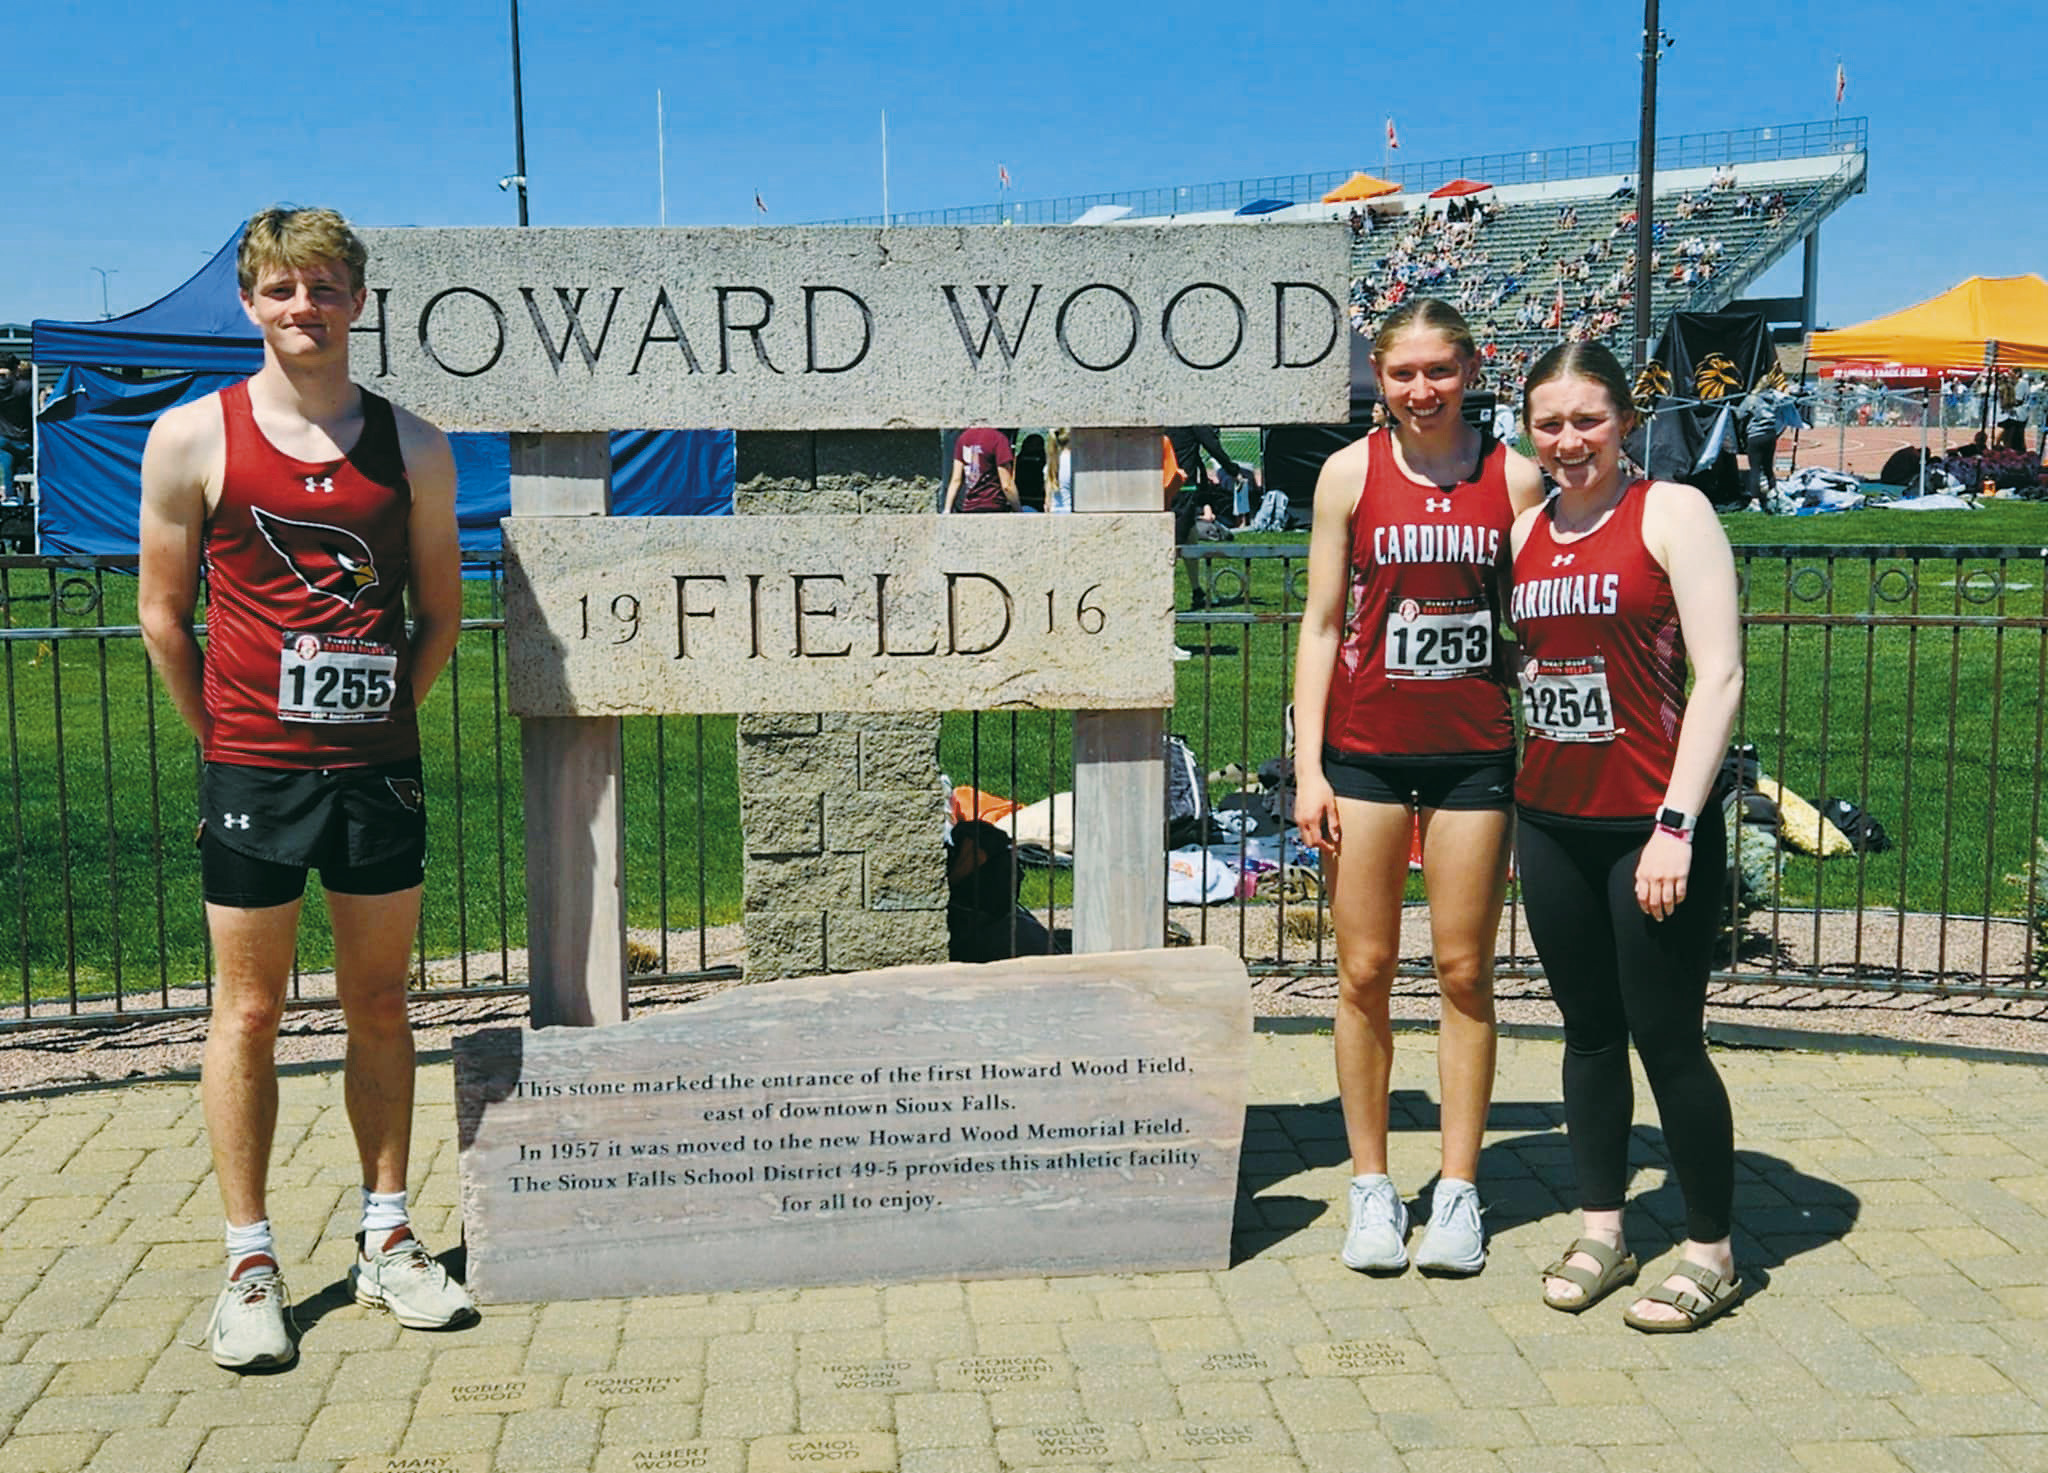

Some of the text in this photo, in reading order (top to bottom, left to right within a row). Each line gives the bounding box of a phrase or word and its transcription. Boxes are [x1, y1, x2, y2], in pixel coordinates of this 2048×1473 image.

[350, 281, 1343, 378] HOWARD WOOD
[1374, 524, 1499, 566] CARDINALS
[1511, 573, 1619, 623] CARDINALS
[578, 572, 1107, 660] 19 FIELD 16
[1393, 625, 1488, 666] 1253
[288, 665, 391, 710] 1255
[1525, 687, 1608, 728] 1254
[516, 1080, 562, 1098] This
[569, 1082, 625, 1097] stone
[633, 1075, 713, 1093] marked
[721, 1074, 754, 1089] the
[761, 1073, 854, 1089] entrance
[861, 1068, 882, 1085] of
[889, 1066, 921, 1083] the
[928, 1064, 972, 1082] first
[981, 1061, 1061, 1080] Howard
[1071, 1059, 1128, 1076] Wood
[704, 1094, 1016, 1121] east of downtown Sioux Falls.
[519, 1118, 1190, 1161] In 1957 it was moved to the new Howard Wood Memorial Field.
[509, 1149, 1200, 1193] The Sioux Falls School District 49-5 provides this athletic facility
[782, 1190, 942, 1212] for all to enjoy.
[959, 1357, 1048, 1368] GEORGIA
[1206, 1352, 1258, 1362] JOHN
[583, 1376, 682, 1388] DOROTHY
[841, 1371, 894, 1380] JOHN
[973, 1374, 1040, 1385] WOOD
[451, 1381, 527, 1394] ROBERT
[599, 1384, 668, 1395] WOOD
[834, 1378, 901, 1390] WOOD
[453, 1391, 523, 1403] WOOD
[1031, 1426, 1106, 1437] ROLLIN
[787, 1440, 860, 1451] CAROL
[1184, 1435, 1254, 1446] WOOD
[631, 1447, 710, 1460] ALBERT
[787, 1450, 861, 1462] WOOD
[1038, 1445, 1110, 1457] WOOD
[386, 1457, 450, 1469] MARY
[635, 1457, 708, 1471] WOOD
